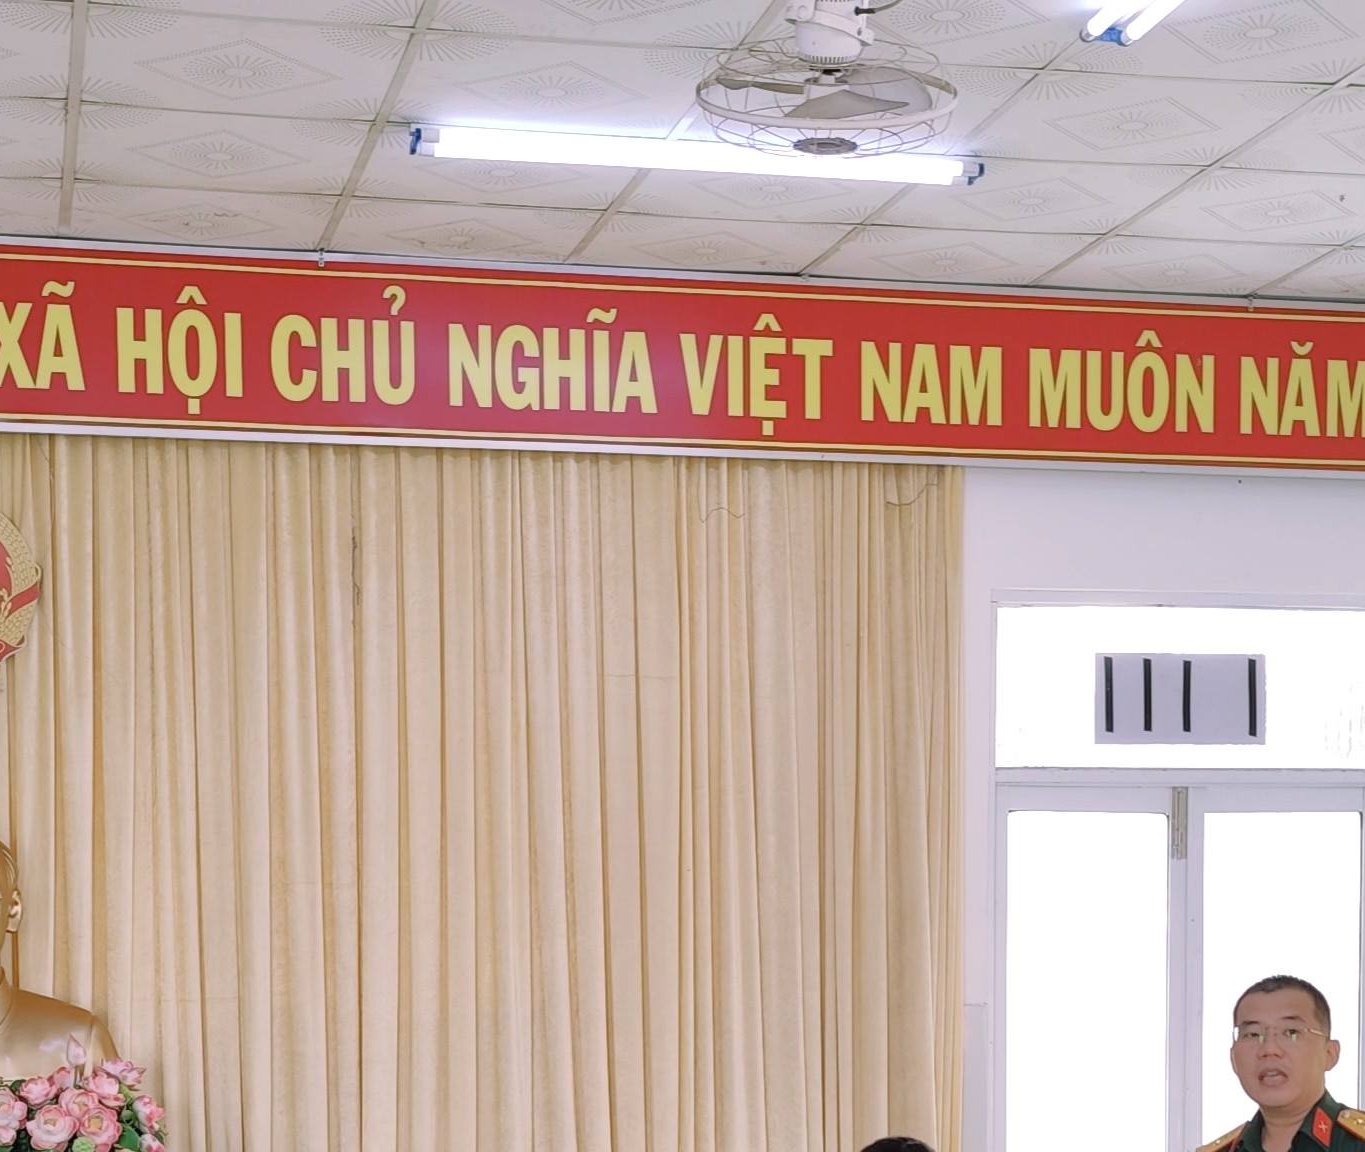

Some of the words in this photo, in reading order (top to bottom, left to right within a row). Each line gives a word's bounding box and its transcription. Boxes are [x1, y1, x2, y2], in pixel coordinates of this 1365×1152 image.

[116, 286, 242, 415] HỘI
[271, 285, 416, 405] CHỦ
[448, 307, 655, 414] NGHĨA
[679, 313, 834, 436] VIỆT
[861, 341, 1003, 426] NAM
[1028, 329, 1216, 433] MUÔN
